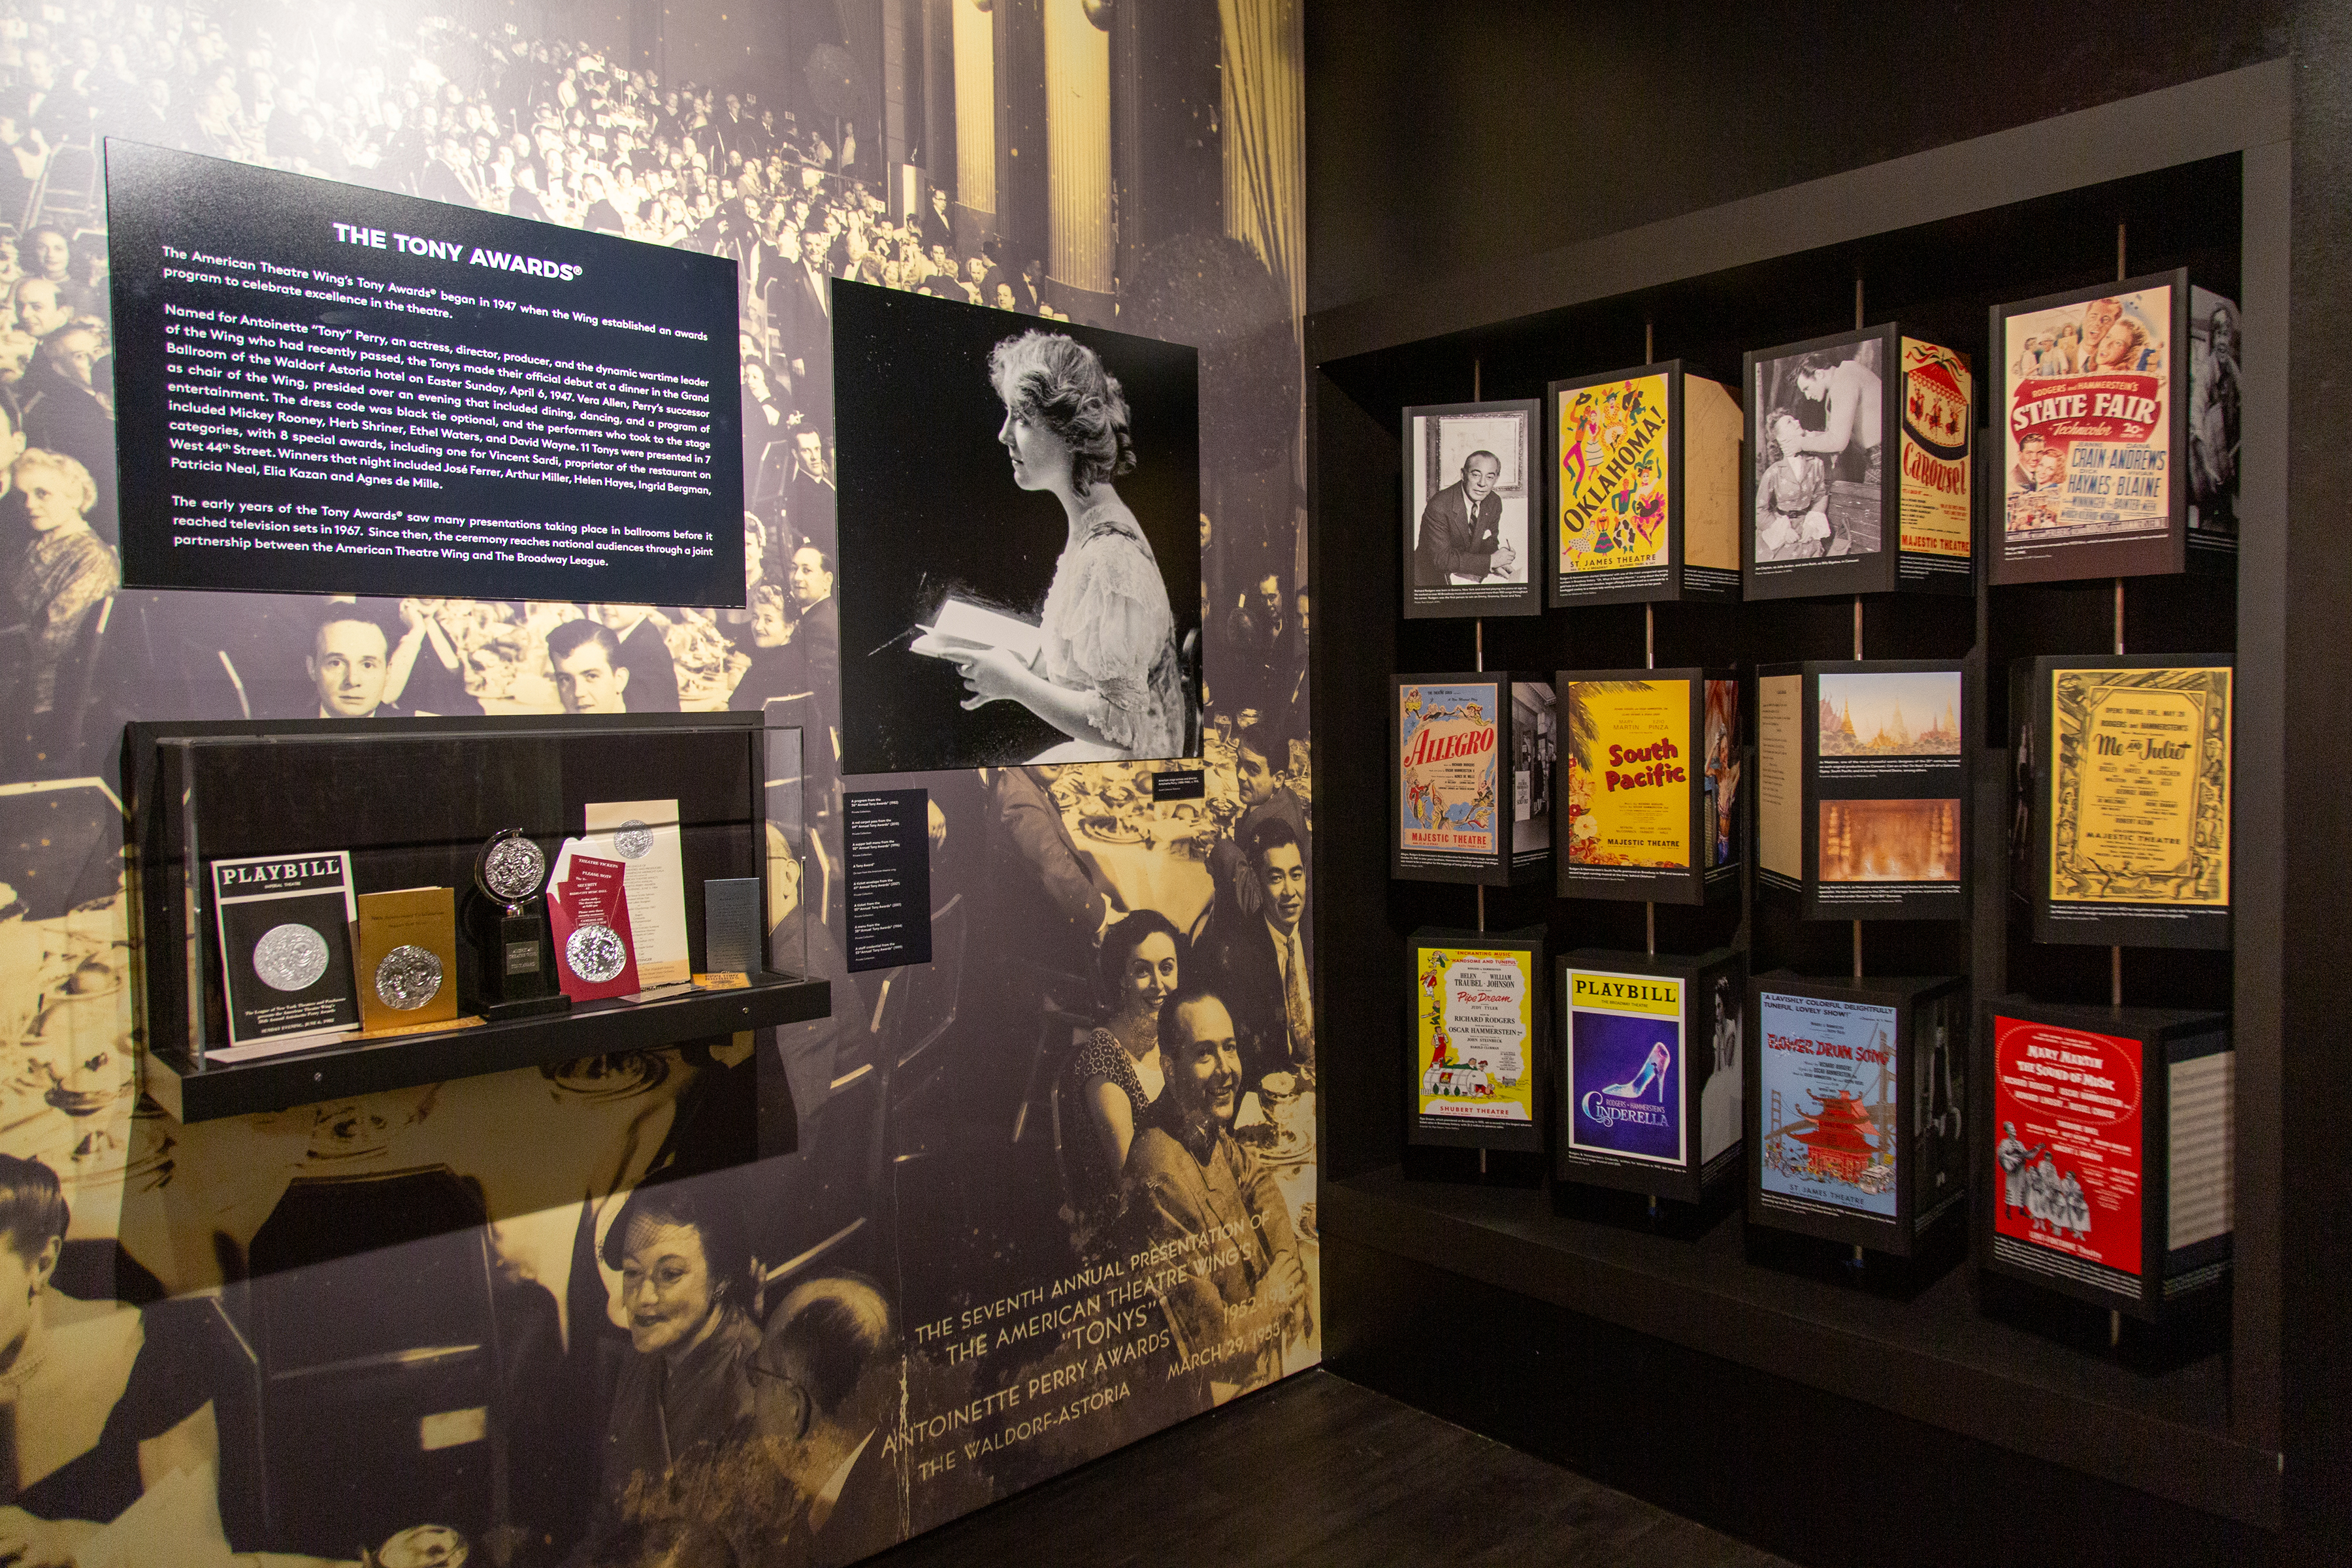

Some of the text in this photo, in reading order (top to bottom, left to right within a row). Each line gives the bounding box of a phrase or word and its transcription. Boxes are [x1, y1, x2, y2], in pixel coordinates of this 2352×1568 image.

[333, 222, 387, 250] THE
[393, 233, 464, 262] TONY
[161, 245, 188, 260] The
[191, 251, 256, 271] American
[259, 261, 309, 279] Theatre
[356, 277, 385, 293] Tony
[440, 290, 476, 306] began
[479, 296, 491, 308] in
[493, 299, 517, 312] 1947
[519, 304, 549, 317] when
[551, 308, 570, 320] the
[572, 311, 598, 327] Wing
[601, 318, 656, 333] established
[659, 327, 672, 336] an
[674, 330, 708, 342] awards
[163, 267, 453, 319] program to celebrate excellence in the theatre.
[164, 303, 215, 321] Named
[218, 311, 238, 324] for
[240, 314, 309, 334] Antoinette
[355, 330, 389, 346] Perry,
[391, 338, 407, 347] an
[409, 340, 453, 355] actress,
[455, 344, 501, 361] director,
[503, 353, 553, 368] producer,
[554, 360, 575, 370] and
[576, 361, 594, 372] the
[595, 363, 638, 378] dynamic
[638, 371, 679, 384] wartime
[680, 375, 710, 387] leader
[2032, 384, 2066, 397] RODGERS
[2078, 382, 2138, 391] HAMMERSTEIN'S
[2013, 393, 2155, 431] STATE FAIR
[2053, 421, 2113, 436] Technicolor
[1564, 406, 1665, 532] OKLAHOMA!
[2072, 448, 2106, 468] CRAIN
[2109, 449, 2166, 470] ANDREWS
[2068, 474, 2111, 495] HAYMES
[2117, 476, 2161, 497] BLAINE
[1901, 535, 1970, 552] MAJESTIC THEATRE
[1617, 555, 1656, 563] THEATRE
[1404, 727, 1494, 767] ALLEGRO
[1609, 737, 1678, 767] South
[2093, 734, 2124, 756] Me
[2139, 738, 2191, 760] Juliet
[1605, 762, 1686, 792] Pacific
[1413, 833, 1486, 845] MAJESTIC THEATRE
[2086, 832, 2181, 845] MAJESTIC THEATRE
[222, 859, 340, 885] PLAYBILL
[1457, 991, 1512, 1004] Pipe Dream
[1575, 980, 1676, 1003] PLAYBILL
[1772, 996, 1803, 1004] LAVISHLY
[1844, 1004, 1893, 1014] DELIGHTFULLY
[1767, 1032, 1889, 1066] FLOWER DRUM SONG
[2027, 1045, 2103, 1070] MARY MARTIN
[2016, 1060, 2115, 1091] THE SOUND OF MUSIC
[1606, 1099, 1665, 1113] RODGERS HAMMERSTEIN'S
[1803, 1186, 1827, 1197] JAMES
[1831, 1191, 1864, 1205] THEATRE
[915, 1211, 1269, 1343] THE SEVENTH ANNUAL PRESENTATION OF
[946, 1243, 1252, 1365] THE AMERICAN THEATRE WING'S
[1168, 1343, 1221, 1381] MARCH
[1253, 1322, 1280, 1346] 1953
[881, 1329, 1169, 1458] ANTOINETTE PERRY AWARDS
[919, 1382, 1130, 1481] THE WALDORF-ASTORIA
